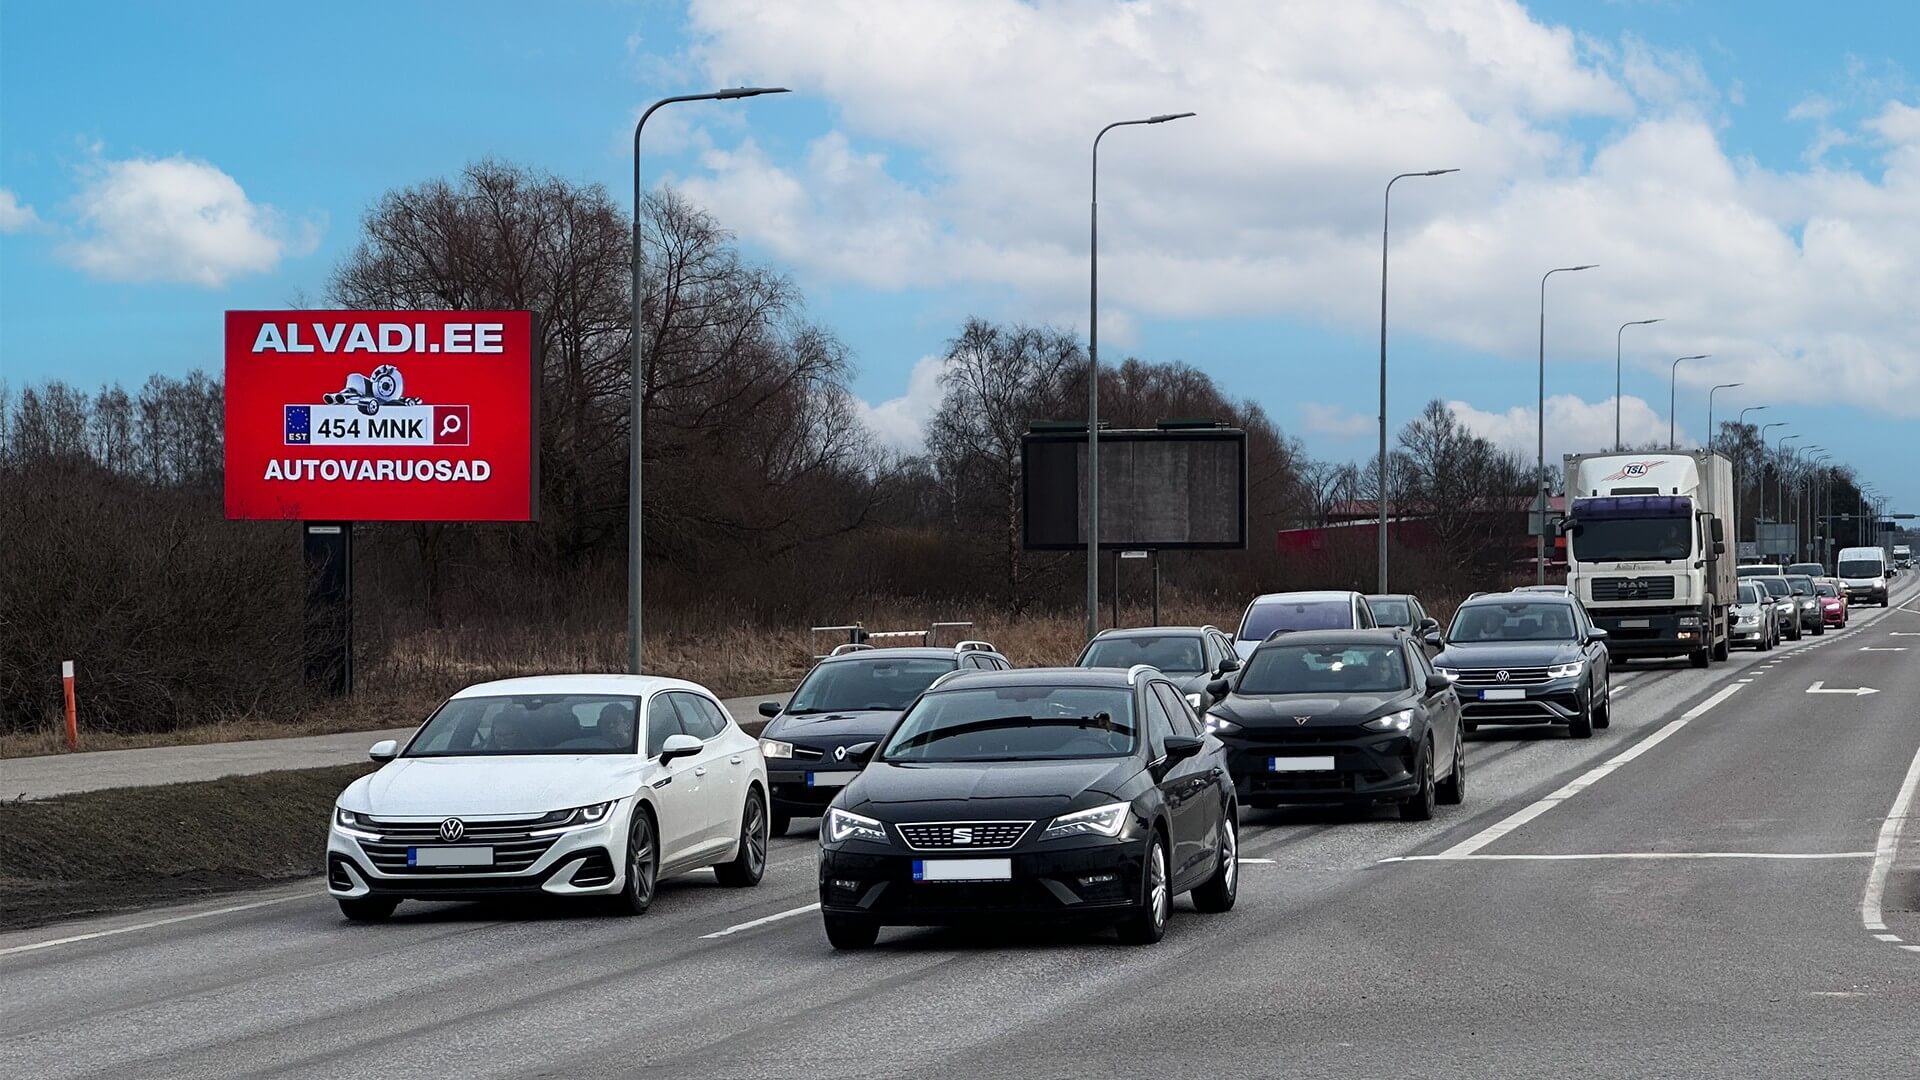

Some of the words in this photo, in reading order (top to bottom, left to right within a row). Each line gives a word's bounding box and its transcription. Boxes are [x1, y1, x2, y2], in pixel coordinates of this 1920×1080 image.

[251, 322, 504, 353] ALVADI.EE
[317, 418, 360, 438] 454
[367, 418, 423, 439] MNK
[288, 433, 307, 441] EST
[263, 459, 491, 482] AUTOVARUOSAD
[1626, 464, 1644, 475] TSL
[1617, 581, 1649, 589] MAN
